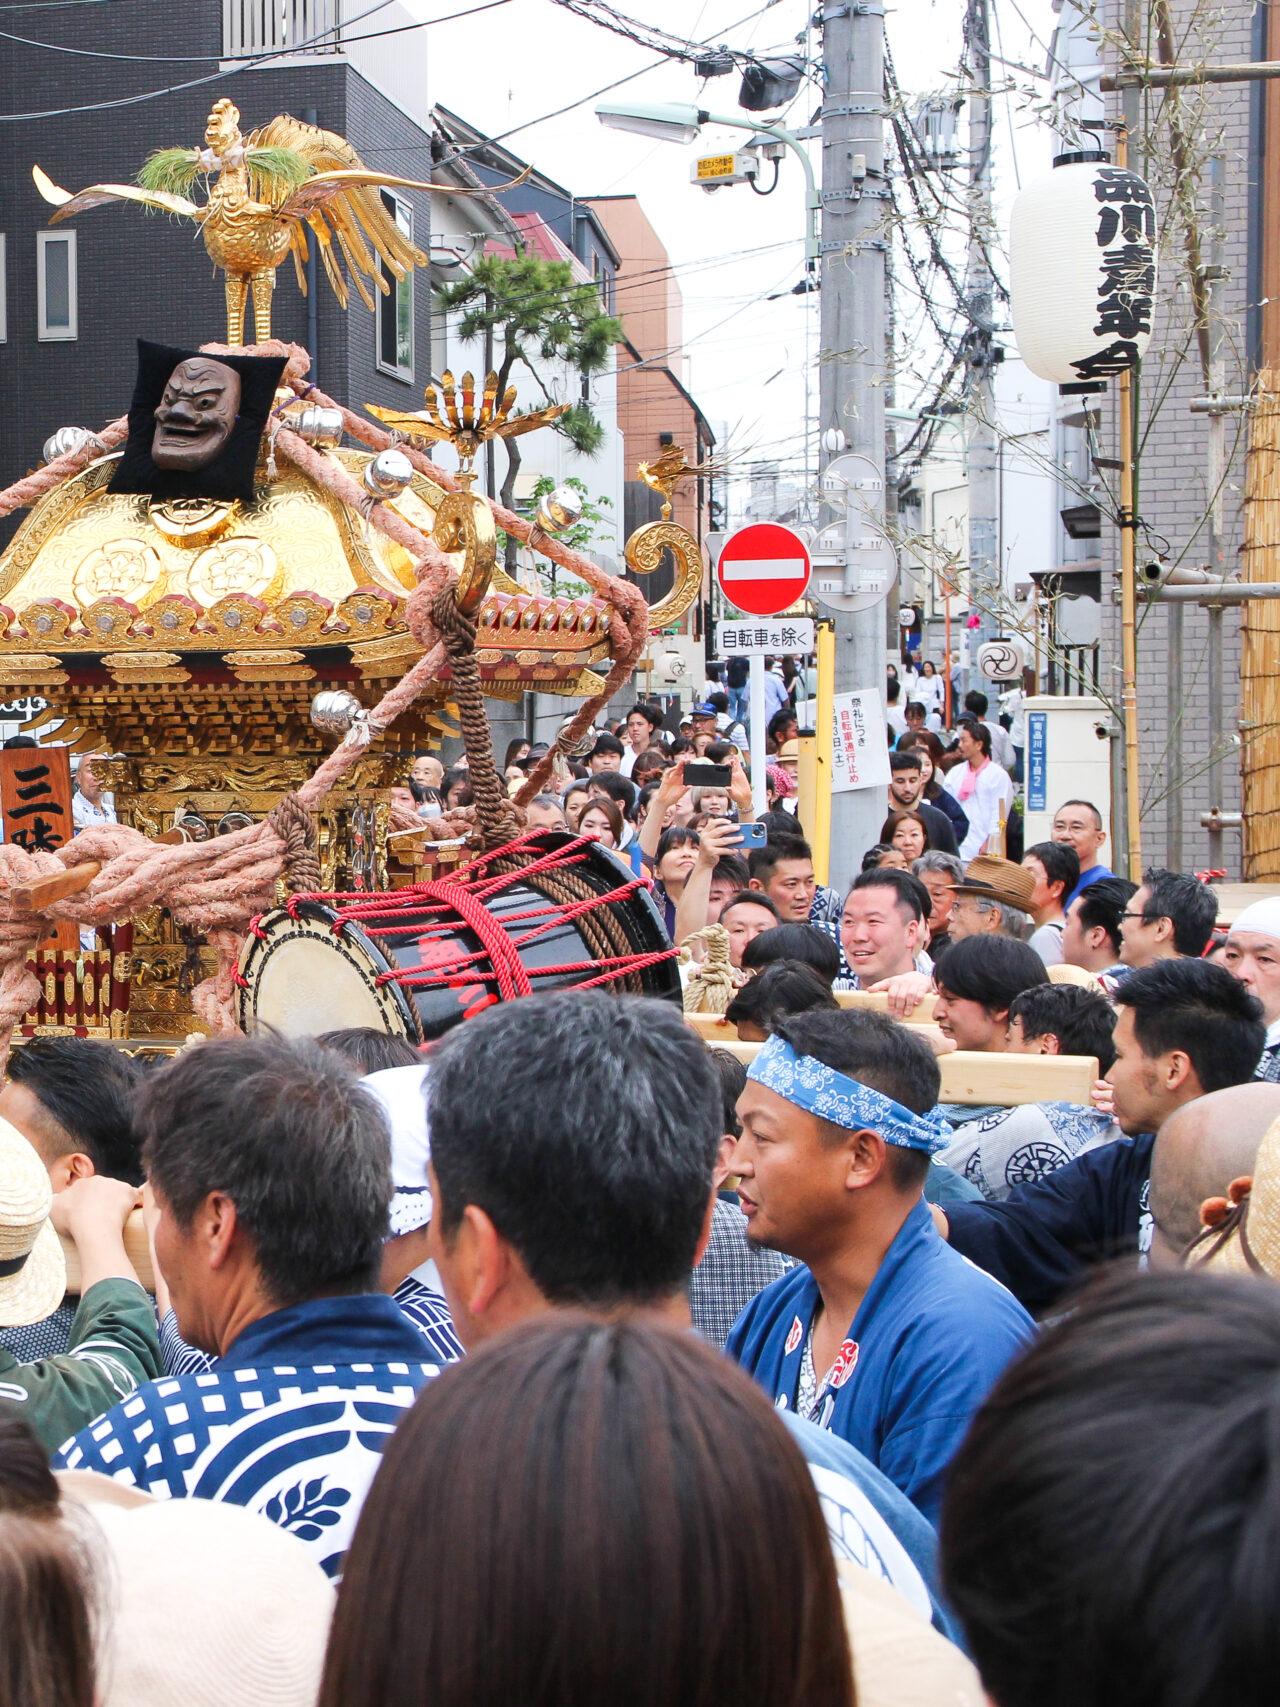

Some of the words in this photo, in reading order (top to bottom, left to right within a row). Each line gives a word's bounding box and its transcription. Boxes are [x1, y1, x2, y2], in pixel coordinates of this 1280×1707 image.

[723, 627, 807, 648] 自転車を除く
[840, 710, 859, 783] 自転車通行止め
[851, 697, 866, 747] 祭礼につき
[1032, 722, 1042, 787] 南品川一丁目2
